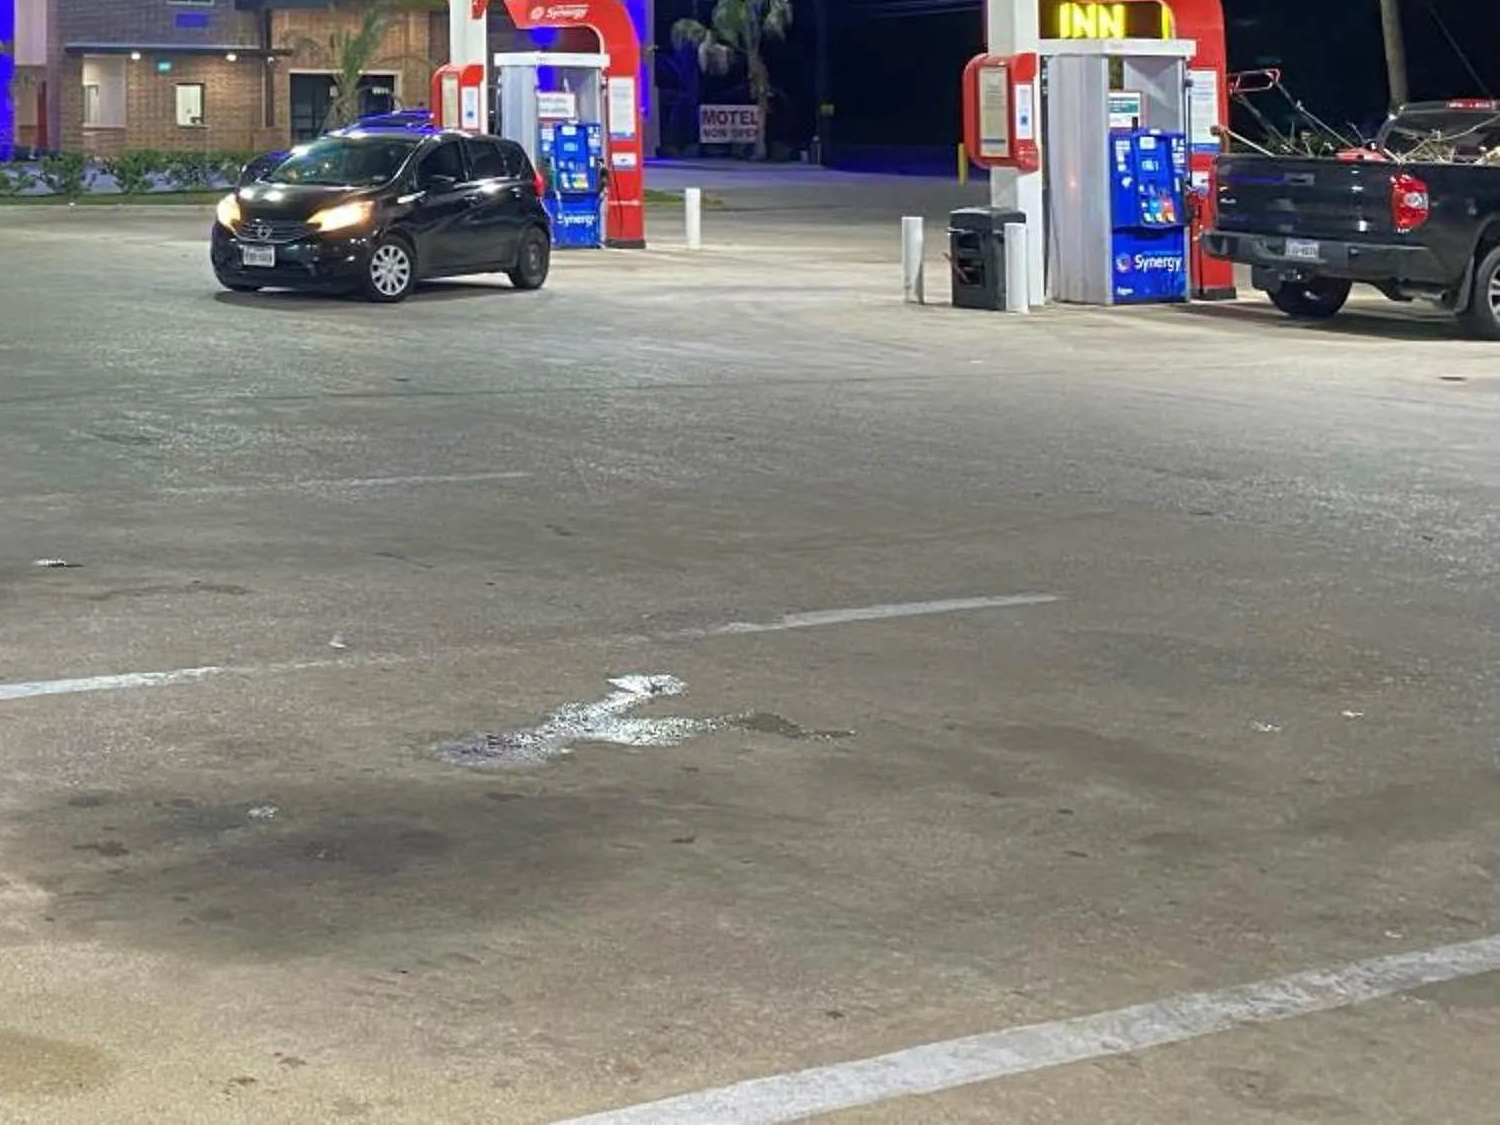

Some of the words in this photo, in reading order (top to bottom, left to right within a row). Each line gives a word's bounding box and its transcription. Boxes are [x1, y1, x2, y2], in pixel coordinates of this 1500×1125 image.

[545, 7, 588, 19] Synergy
[1059, 2, 1125, 39] INN
[701, 109, 759, 125] MOTEL
[1134, 254, 1182, 273] Synergy
